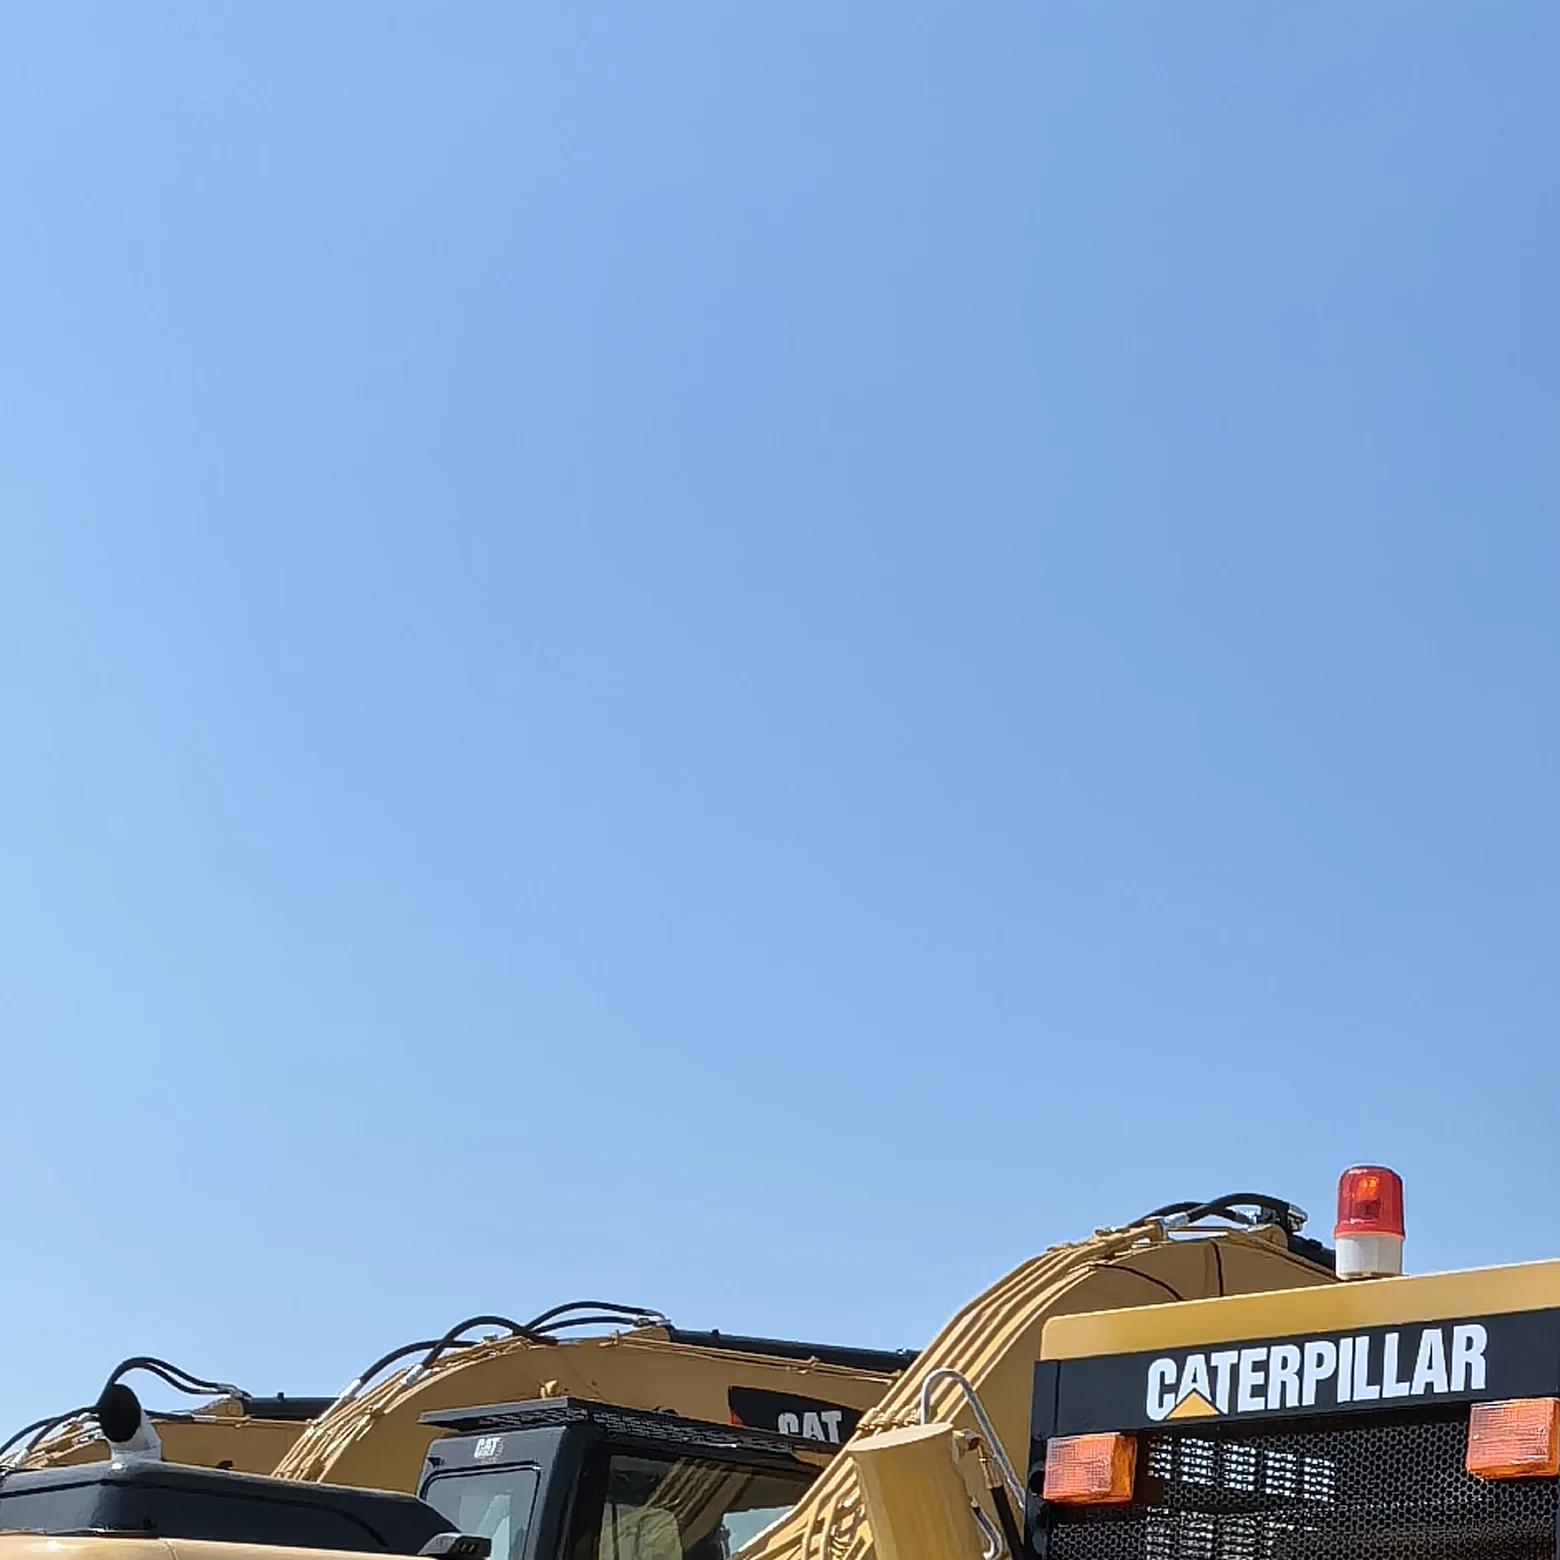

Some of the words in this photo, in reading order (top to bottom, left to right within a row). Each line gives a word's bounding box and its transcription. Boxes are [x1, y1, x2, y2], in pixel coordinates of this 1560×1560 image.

[1146, 1323, 1488, 1421] CATERPILLAR
[778, 1410, 842, 1443] CAT
[474, 1437, 502, 1458] CAT
